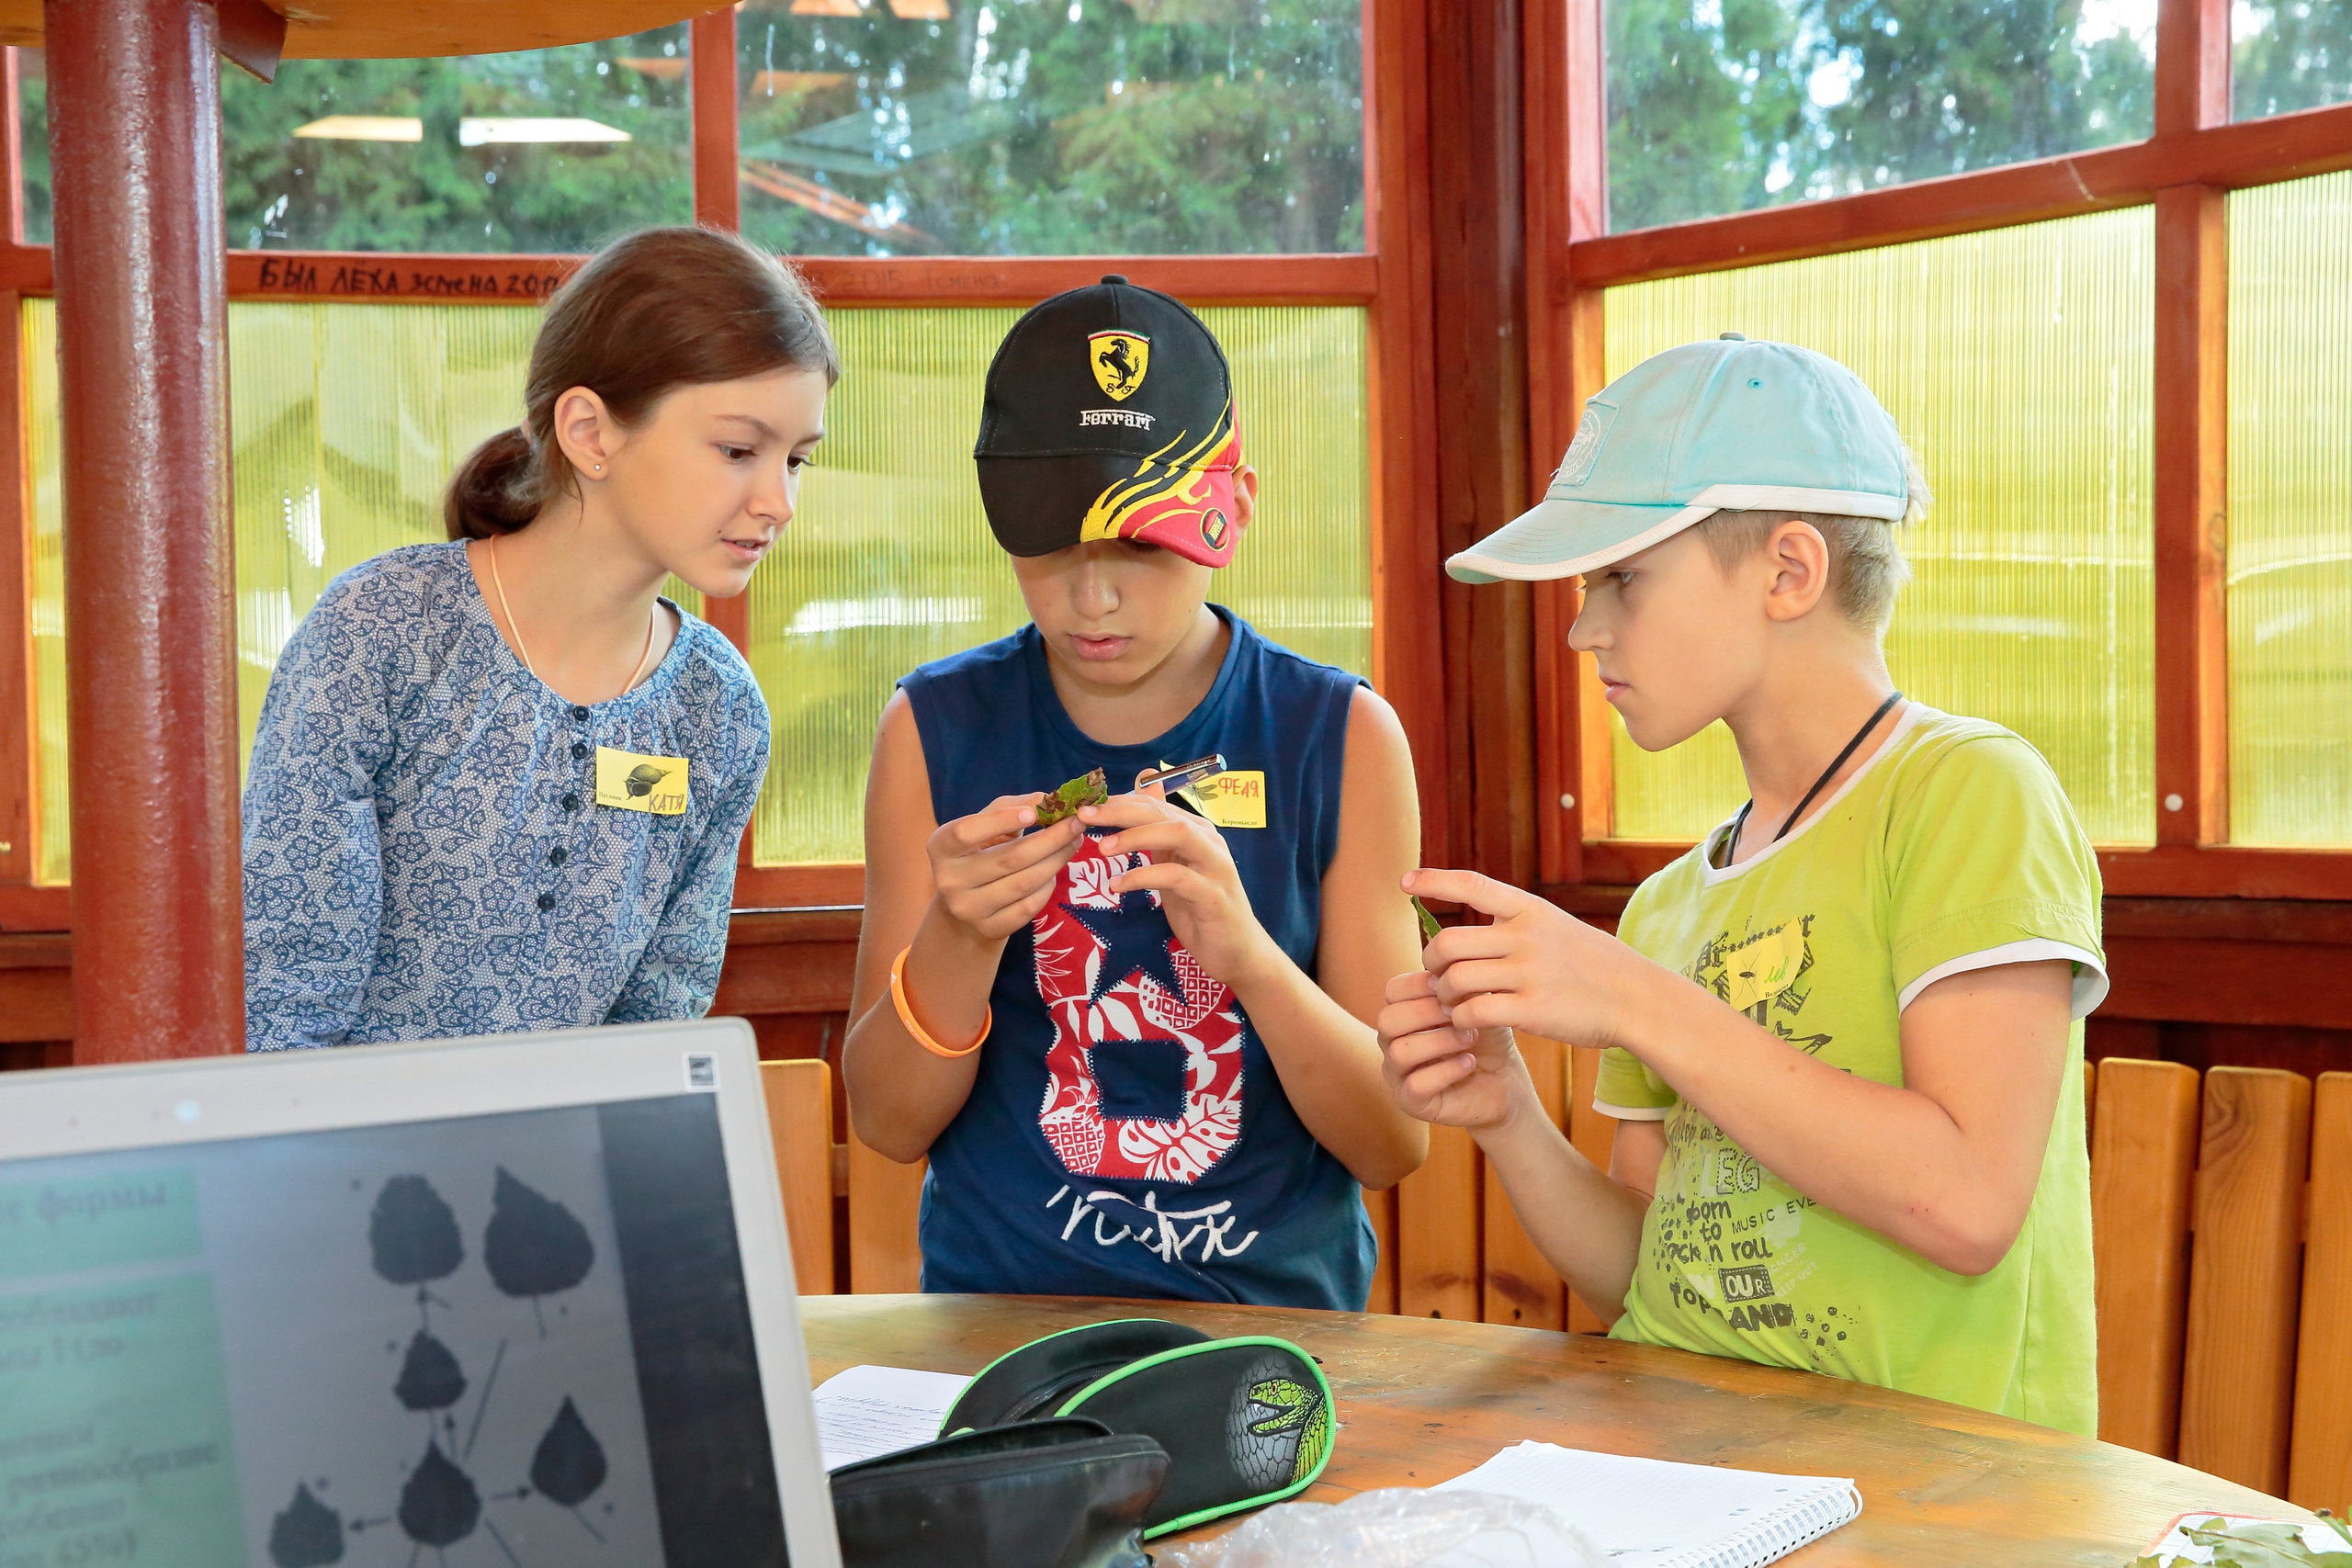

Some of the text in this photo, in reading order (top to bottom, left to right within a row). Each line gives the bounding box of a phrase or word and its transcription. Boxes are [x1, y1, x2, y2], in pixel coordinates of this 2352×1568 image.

[1079, 409, 1156, 431] Ferrari
[649, 793, 684, 813] КАТЯ
[1686, 1200, 1733, 1226] born
[1731, 1196, 1817, 1235] MUSIC EVE
[1700, 1222, 1722, 1245] to
[1730, 1236, 1773, 1262] roll
[1770, 1242, 1808, 1277] ANGER
[1724, 1274, 1766, 1298] OUR
[1723, 1303, 1797, 1332] AND
